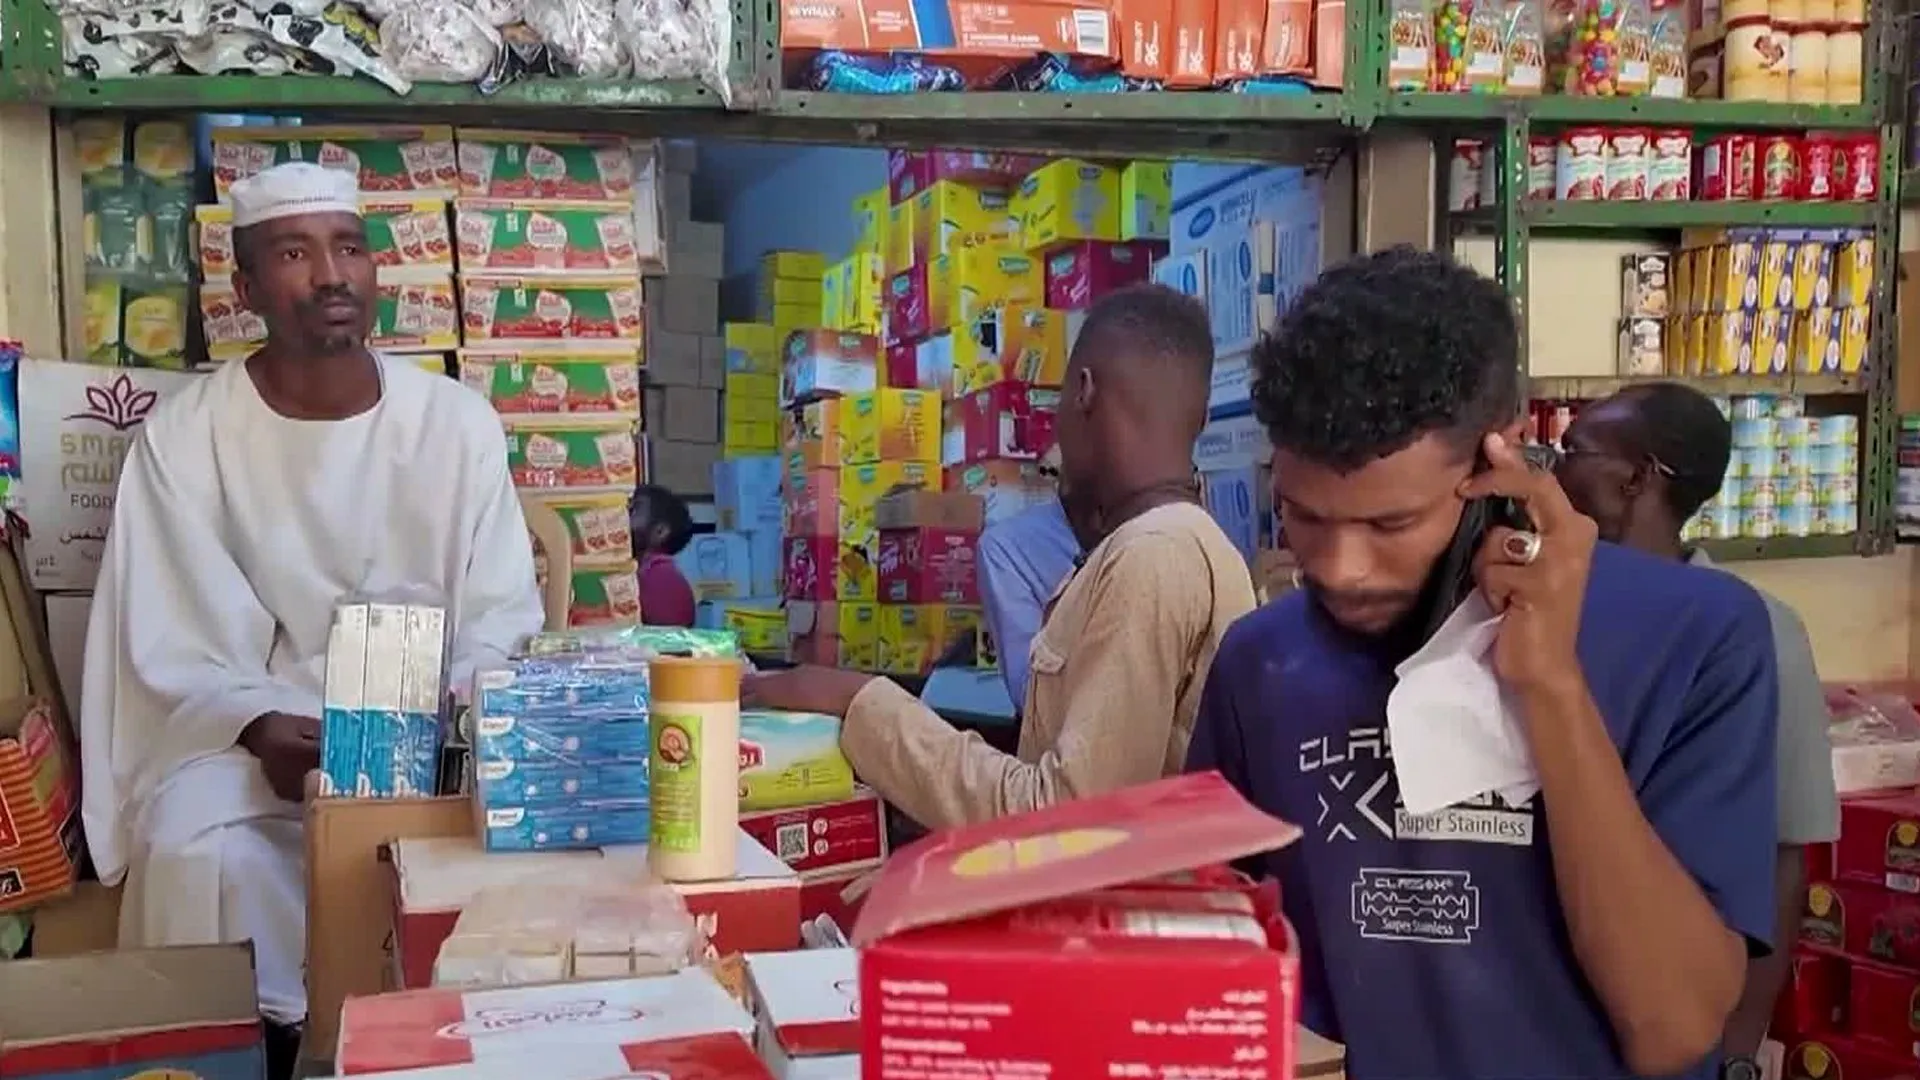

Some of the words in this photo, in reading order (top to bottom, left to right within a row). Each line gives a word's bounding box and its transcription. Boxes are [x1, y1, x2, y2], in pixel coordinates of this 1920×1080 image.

[61, 434, 134, 456] SMA
[1299, 727, 1392, 772] CLA
[1398, 812, 1442, 834] Super
[1448, 813, 1526, 838] Stainless
[1382, 917, 1411, 934] Super
[1413, 919, 1454, 936] Stainless
